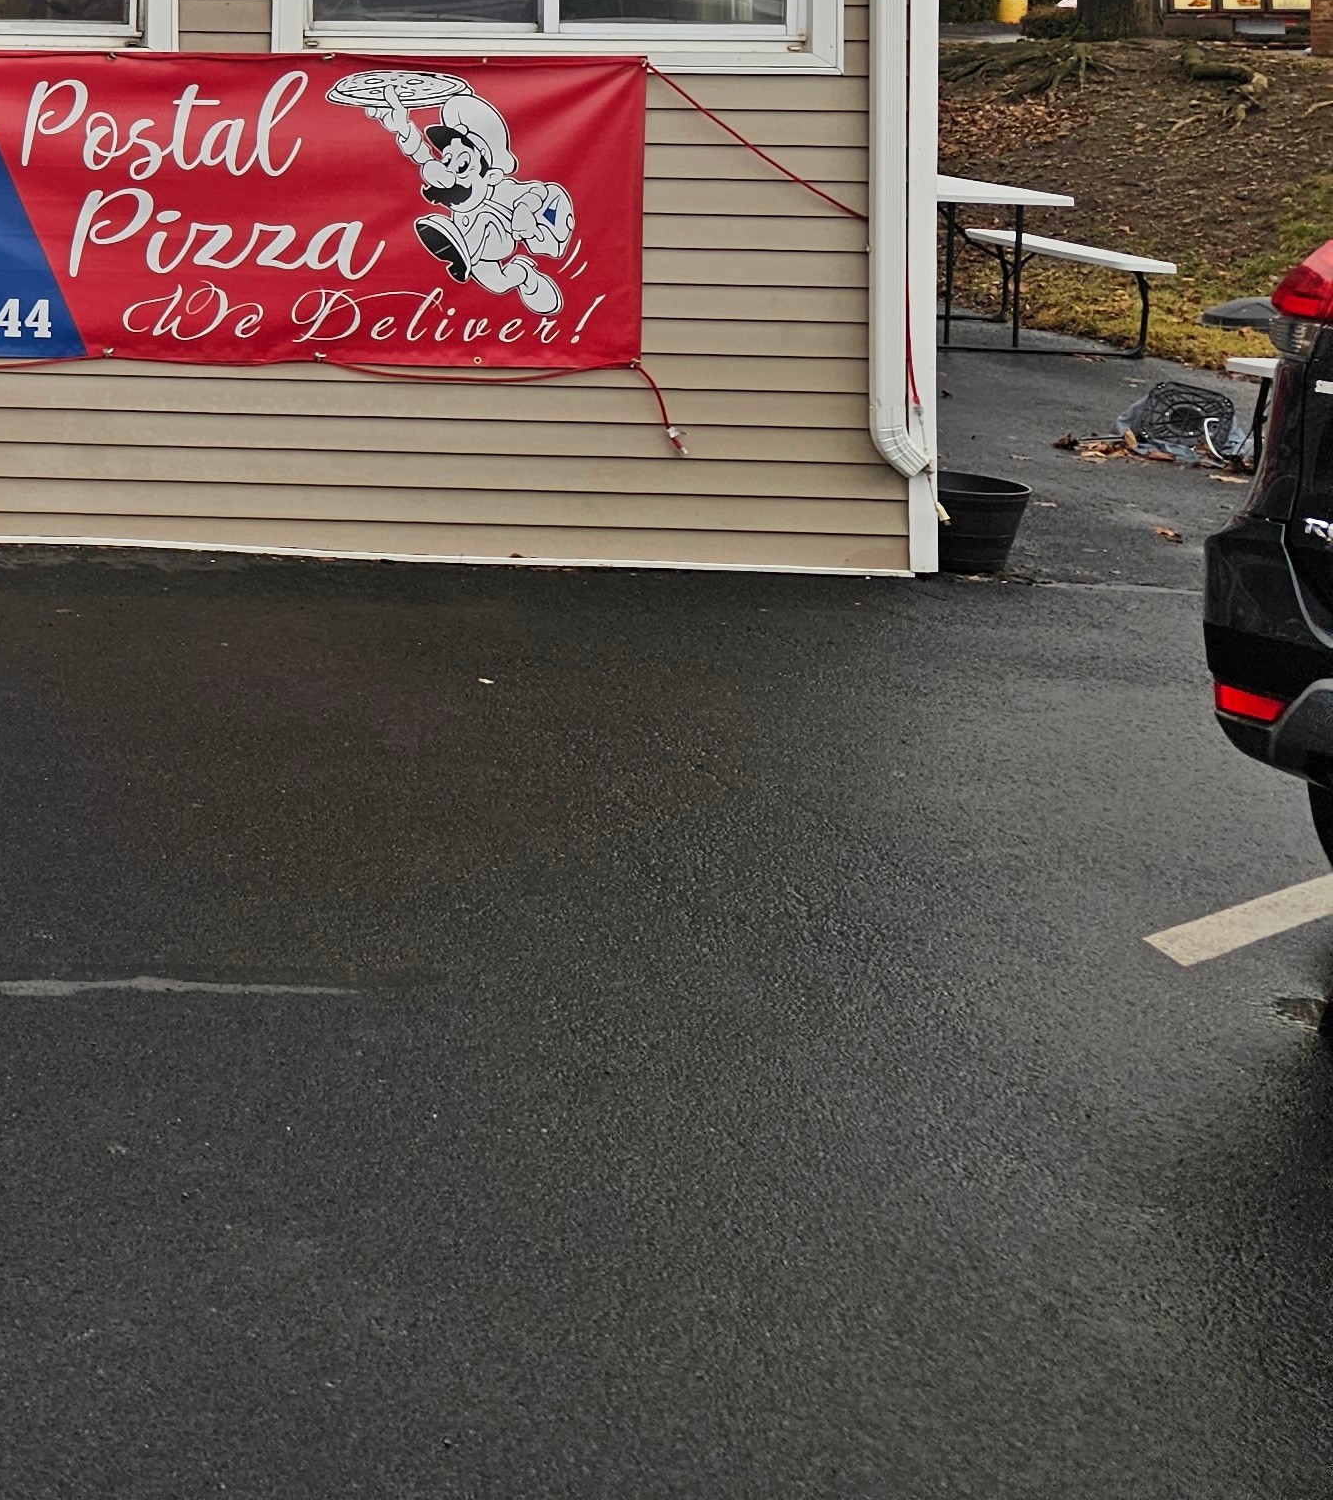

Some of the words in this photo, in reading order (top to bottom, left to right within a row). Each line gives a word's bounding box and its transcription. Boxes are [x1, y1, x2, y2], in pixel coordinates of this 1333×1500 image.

[21, 70, 309, 180] Postal
[69, 187, 386, 280] Pizza
[122, 280, 264, 341] We
[291, 286, 606, 345] Deliver!
